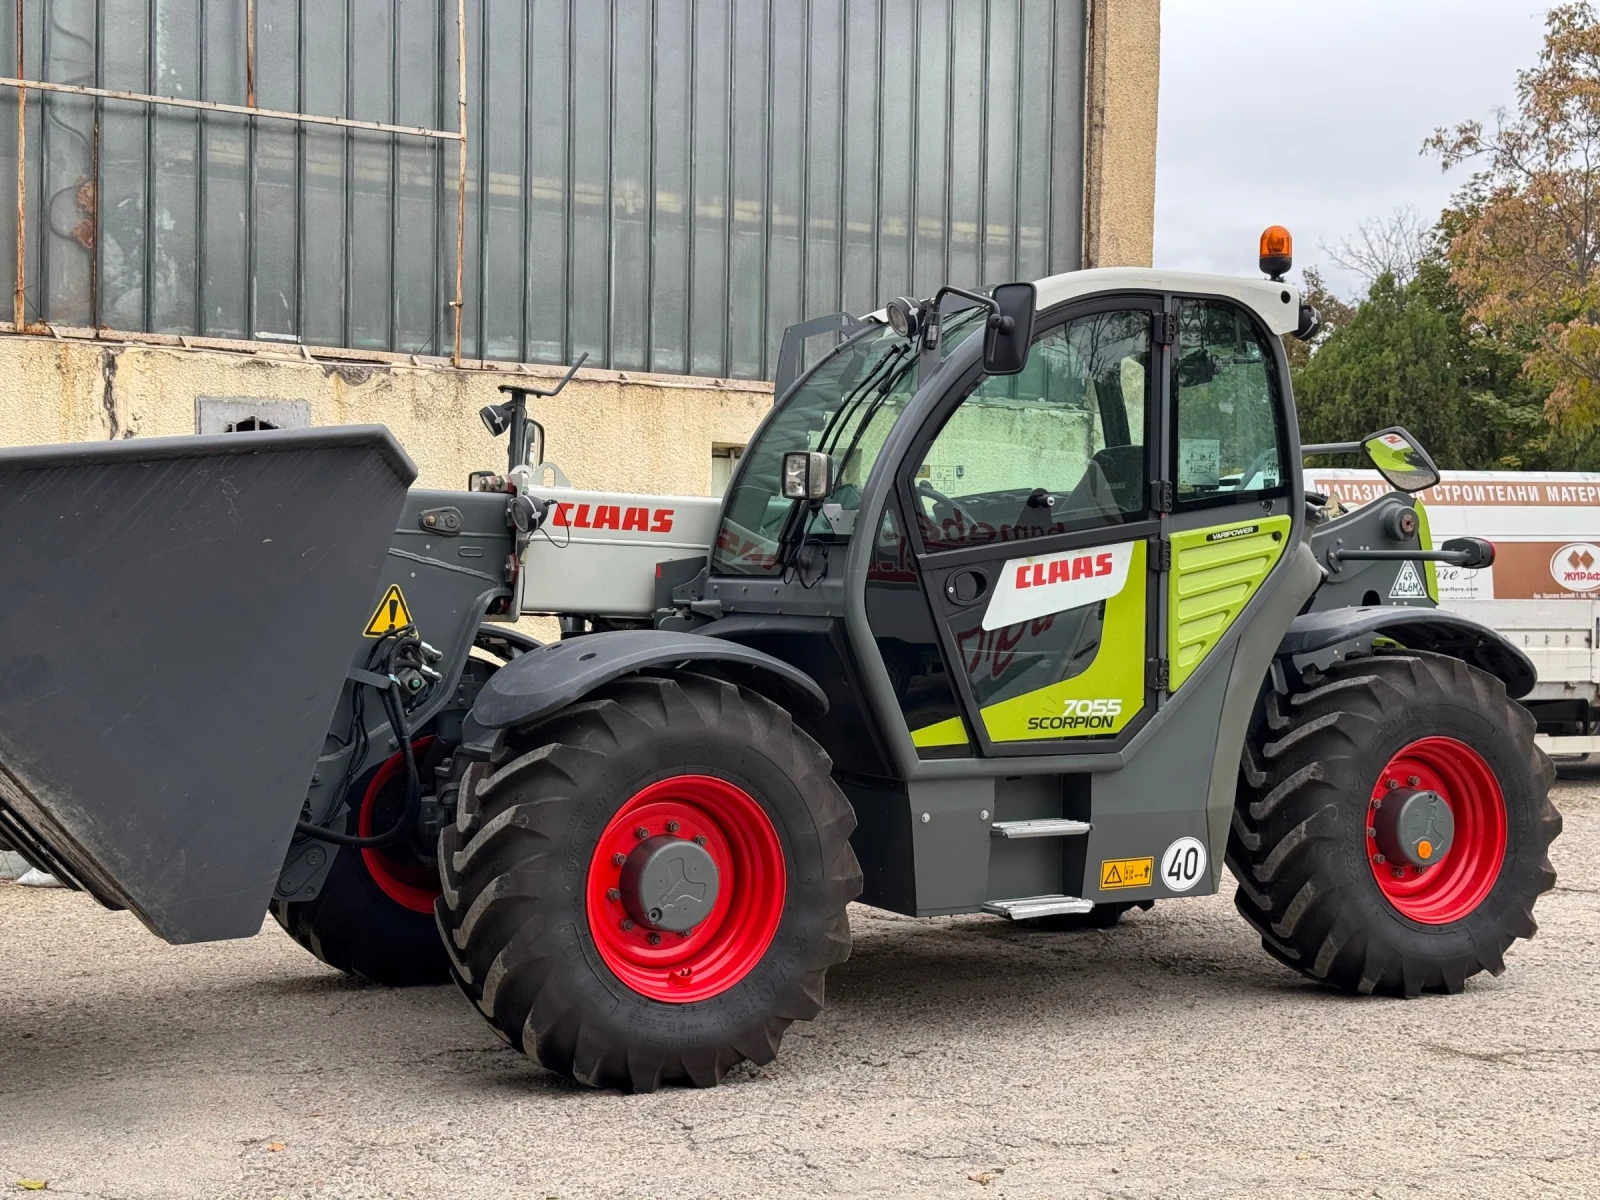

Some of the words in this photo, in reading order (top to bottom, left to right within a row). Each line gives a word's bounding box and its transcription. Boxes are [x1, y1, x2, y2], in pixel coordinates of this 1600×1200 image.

[1432, 484, 1540, 502] СТРОИТЕЛНИ
[552, 502, 675, 533] CLAAS
[1212, 526, 1254, 540] VARIPOWER
[1015, 552, 1113, 589] CLAAS
[1403, 571, 1413, 581] 49
[1062, 698, 1122, 716] 7055
[1027, 716, 1114, 730] SCORPION
[1167, 847, 1199, 881] 40
